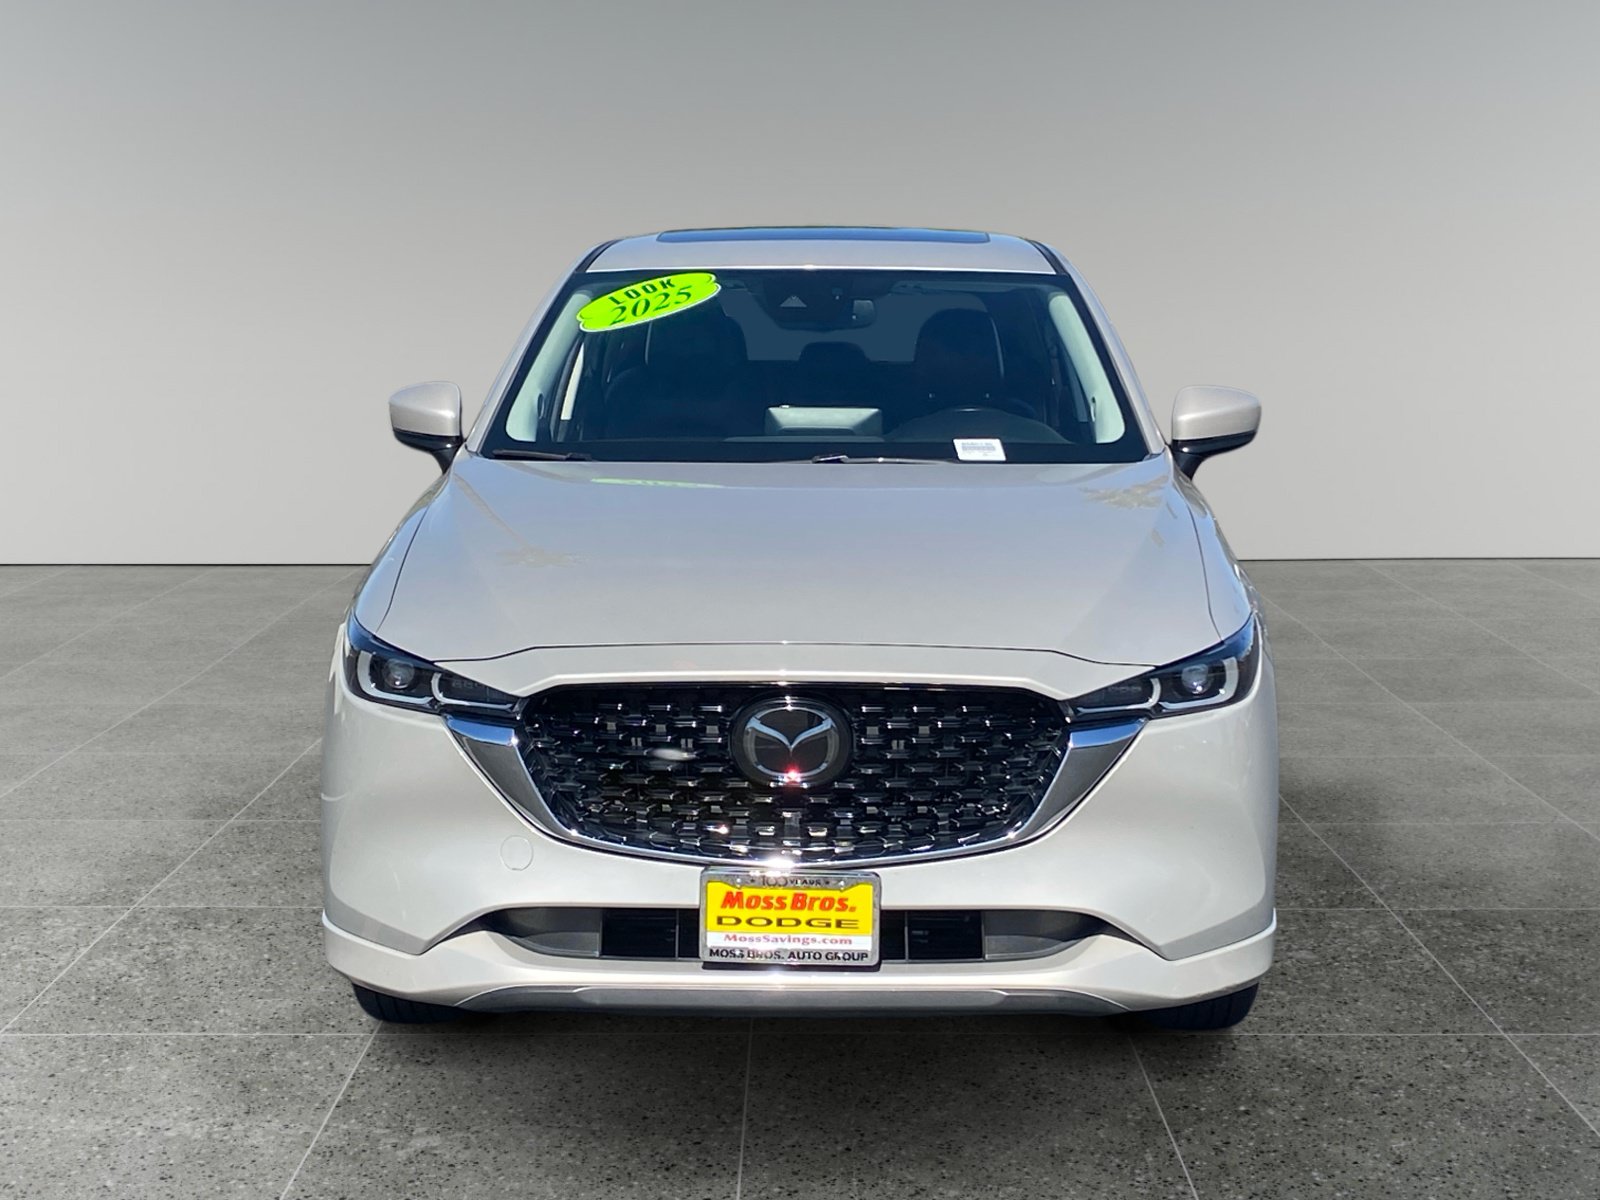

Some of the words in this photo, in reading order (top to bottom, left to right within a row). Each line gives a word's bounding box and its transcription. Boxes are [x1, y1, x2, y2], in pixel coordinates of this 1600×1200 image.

[608, 278, 675, 305] LOOK
[610, 285, 692, 326] 2025
[721, 891, 788, 911] Moss
[790, 893, 857, 913] Bros.
[716, 916, 860, 930] DODGE
[724, 934, 853, 946] MossSavings.com
[709, 948, 744, 959] MOSS
[747, 950, 785, 960] BROS.
[788, 951, 822, 961] AUTO
[825, 952, 869, 961] GROUP
